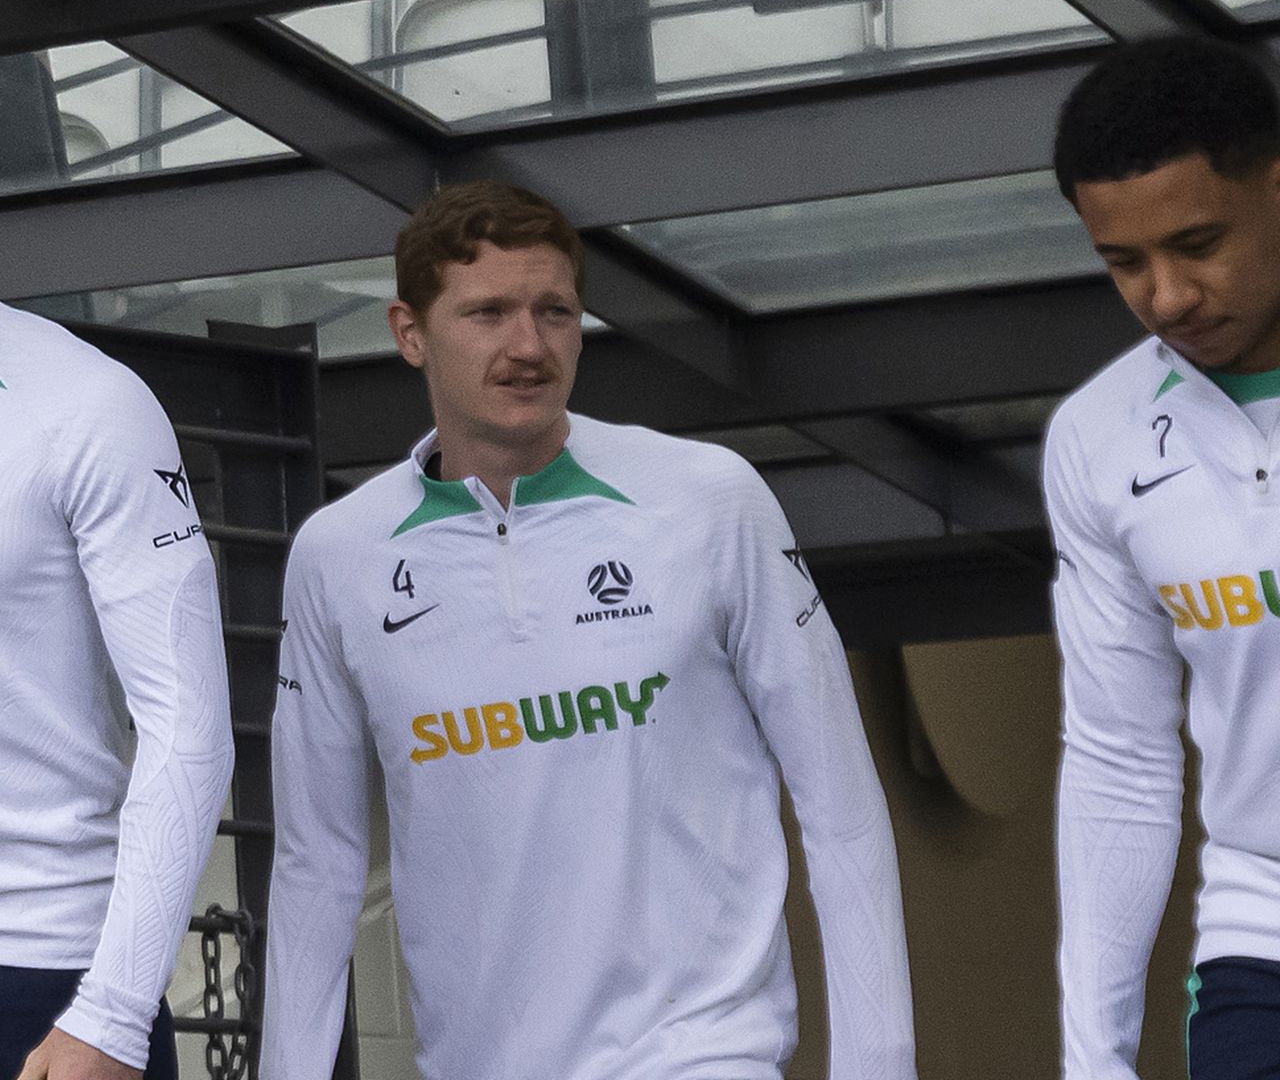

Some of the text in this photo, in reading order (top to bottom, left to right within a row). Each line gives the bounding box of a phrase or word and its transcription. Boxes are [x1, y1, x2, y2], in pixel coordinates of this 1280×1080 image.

[392, 558, 415, 599] 4
[575, 603, 654, 625] AUSTRALIA
[410, 671, 672, 765] SUBWAY
